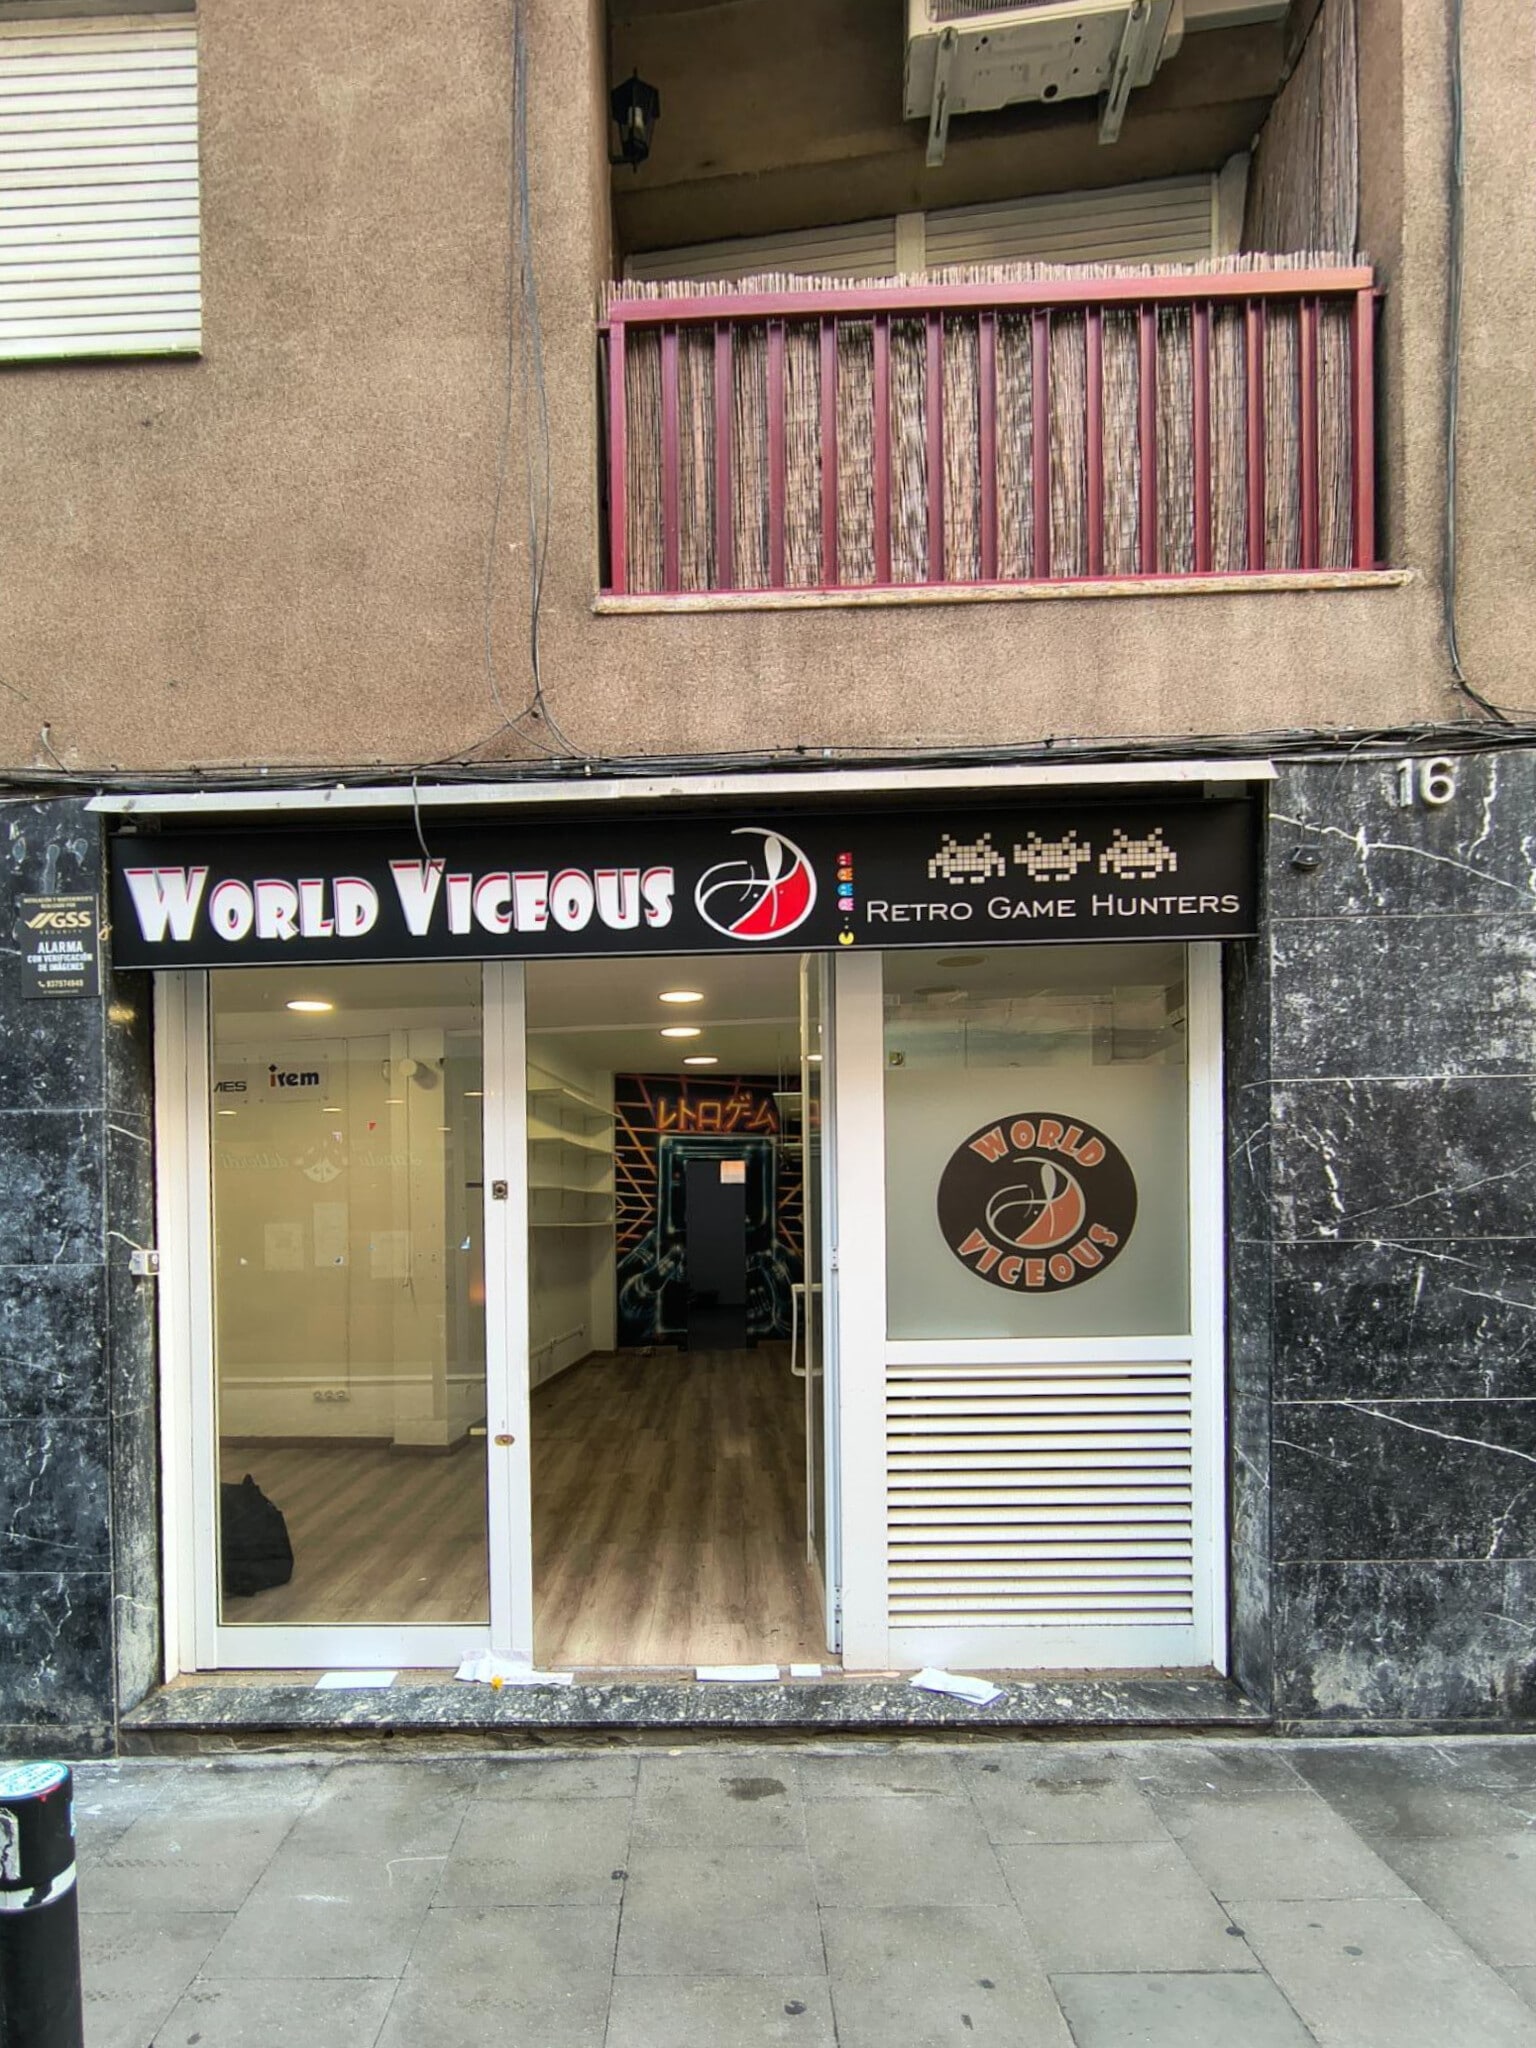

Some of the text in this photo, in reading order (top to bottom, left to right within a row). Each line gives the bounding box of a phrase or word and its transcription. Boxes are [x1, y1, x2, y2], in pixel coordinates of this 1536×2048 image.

[1396, 756, 1457, 807] 16
[50, 910, 92, 929] GSS
[123, 858, 675, 942] WORLD VICEOUS
[866, 893, 1241, 923] RETRO GAME HUNTERS
[37, 941, 84, 954] ALARMA
[968, 1119, 1106, 1167] WORLD
[957, 1223, 1118, 1286] VICEOUS
